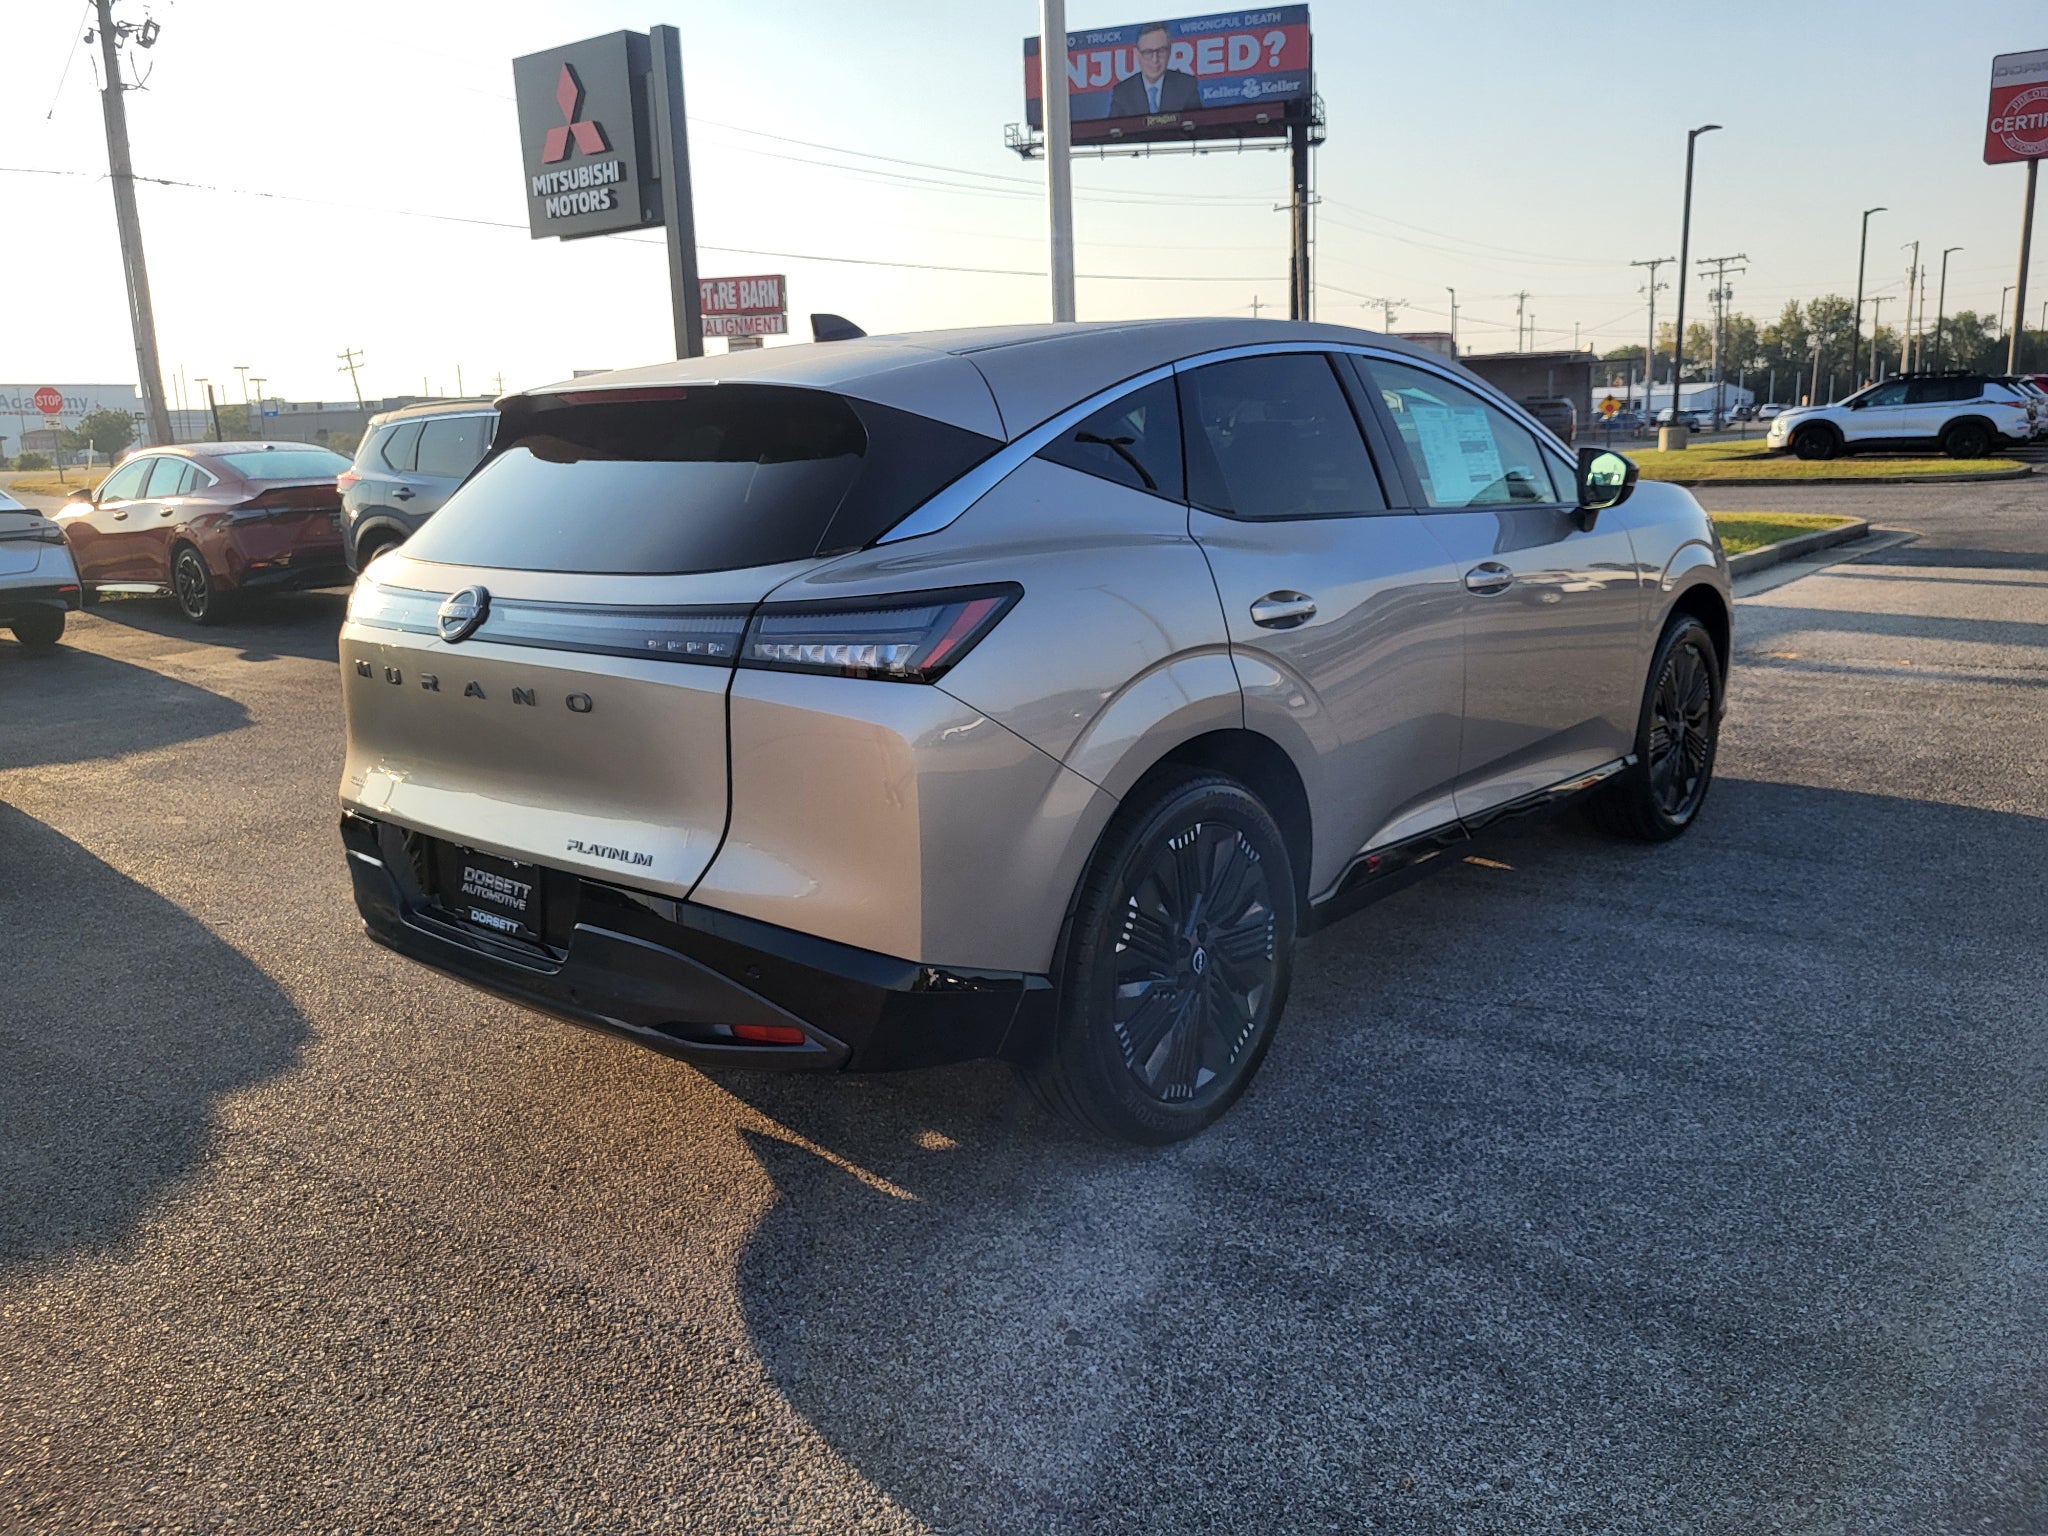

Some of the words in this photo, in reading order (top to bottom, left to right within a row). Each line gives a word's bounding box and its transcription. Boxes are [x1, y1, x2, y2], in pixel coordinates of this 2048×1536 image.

[1086, 32, 1122, 45] TRUCK
[1180, 16, 1242, 34] WRONGFUL
[1244, 11, 1282, 27] DEATH
[1203, 85, 1241, 99] Keller
[1261, 79, 1300, 94] Keller
[532, 160, 620, 197] MITSUBISHI
[545, 188, 611, 219] MOTORS
[739, 279, 779, 309] BARN
[704, 316, 780, 336] ALIGNMENT
[36, 395, 61, 407] STOP
[355, 657, 594, 713] MURANO
[566, 839, 654, 867] PLATINUM
[461, 882, 528, 911] AUTOMOTIVE
[463, 866, 533, 899] DORSETT
[470, 909, 519, 934] DORSETT
